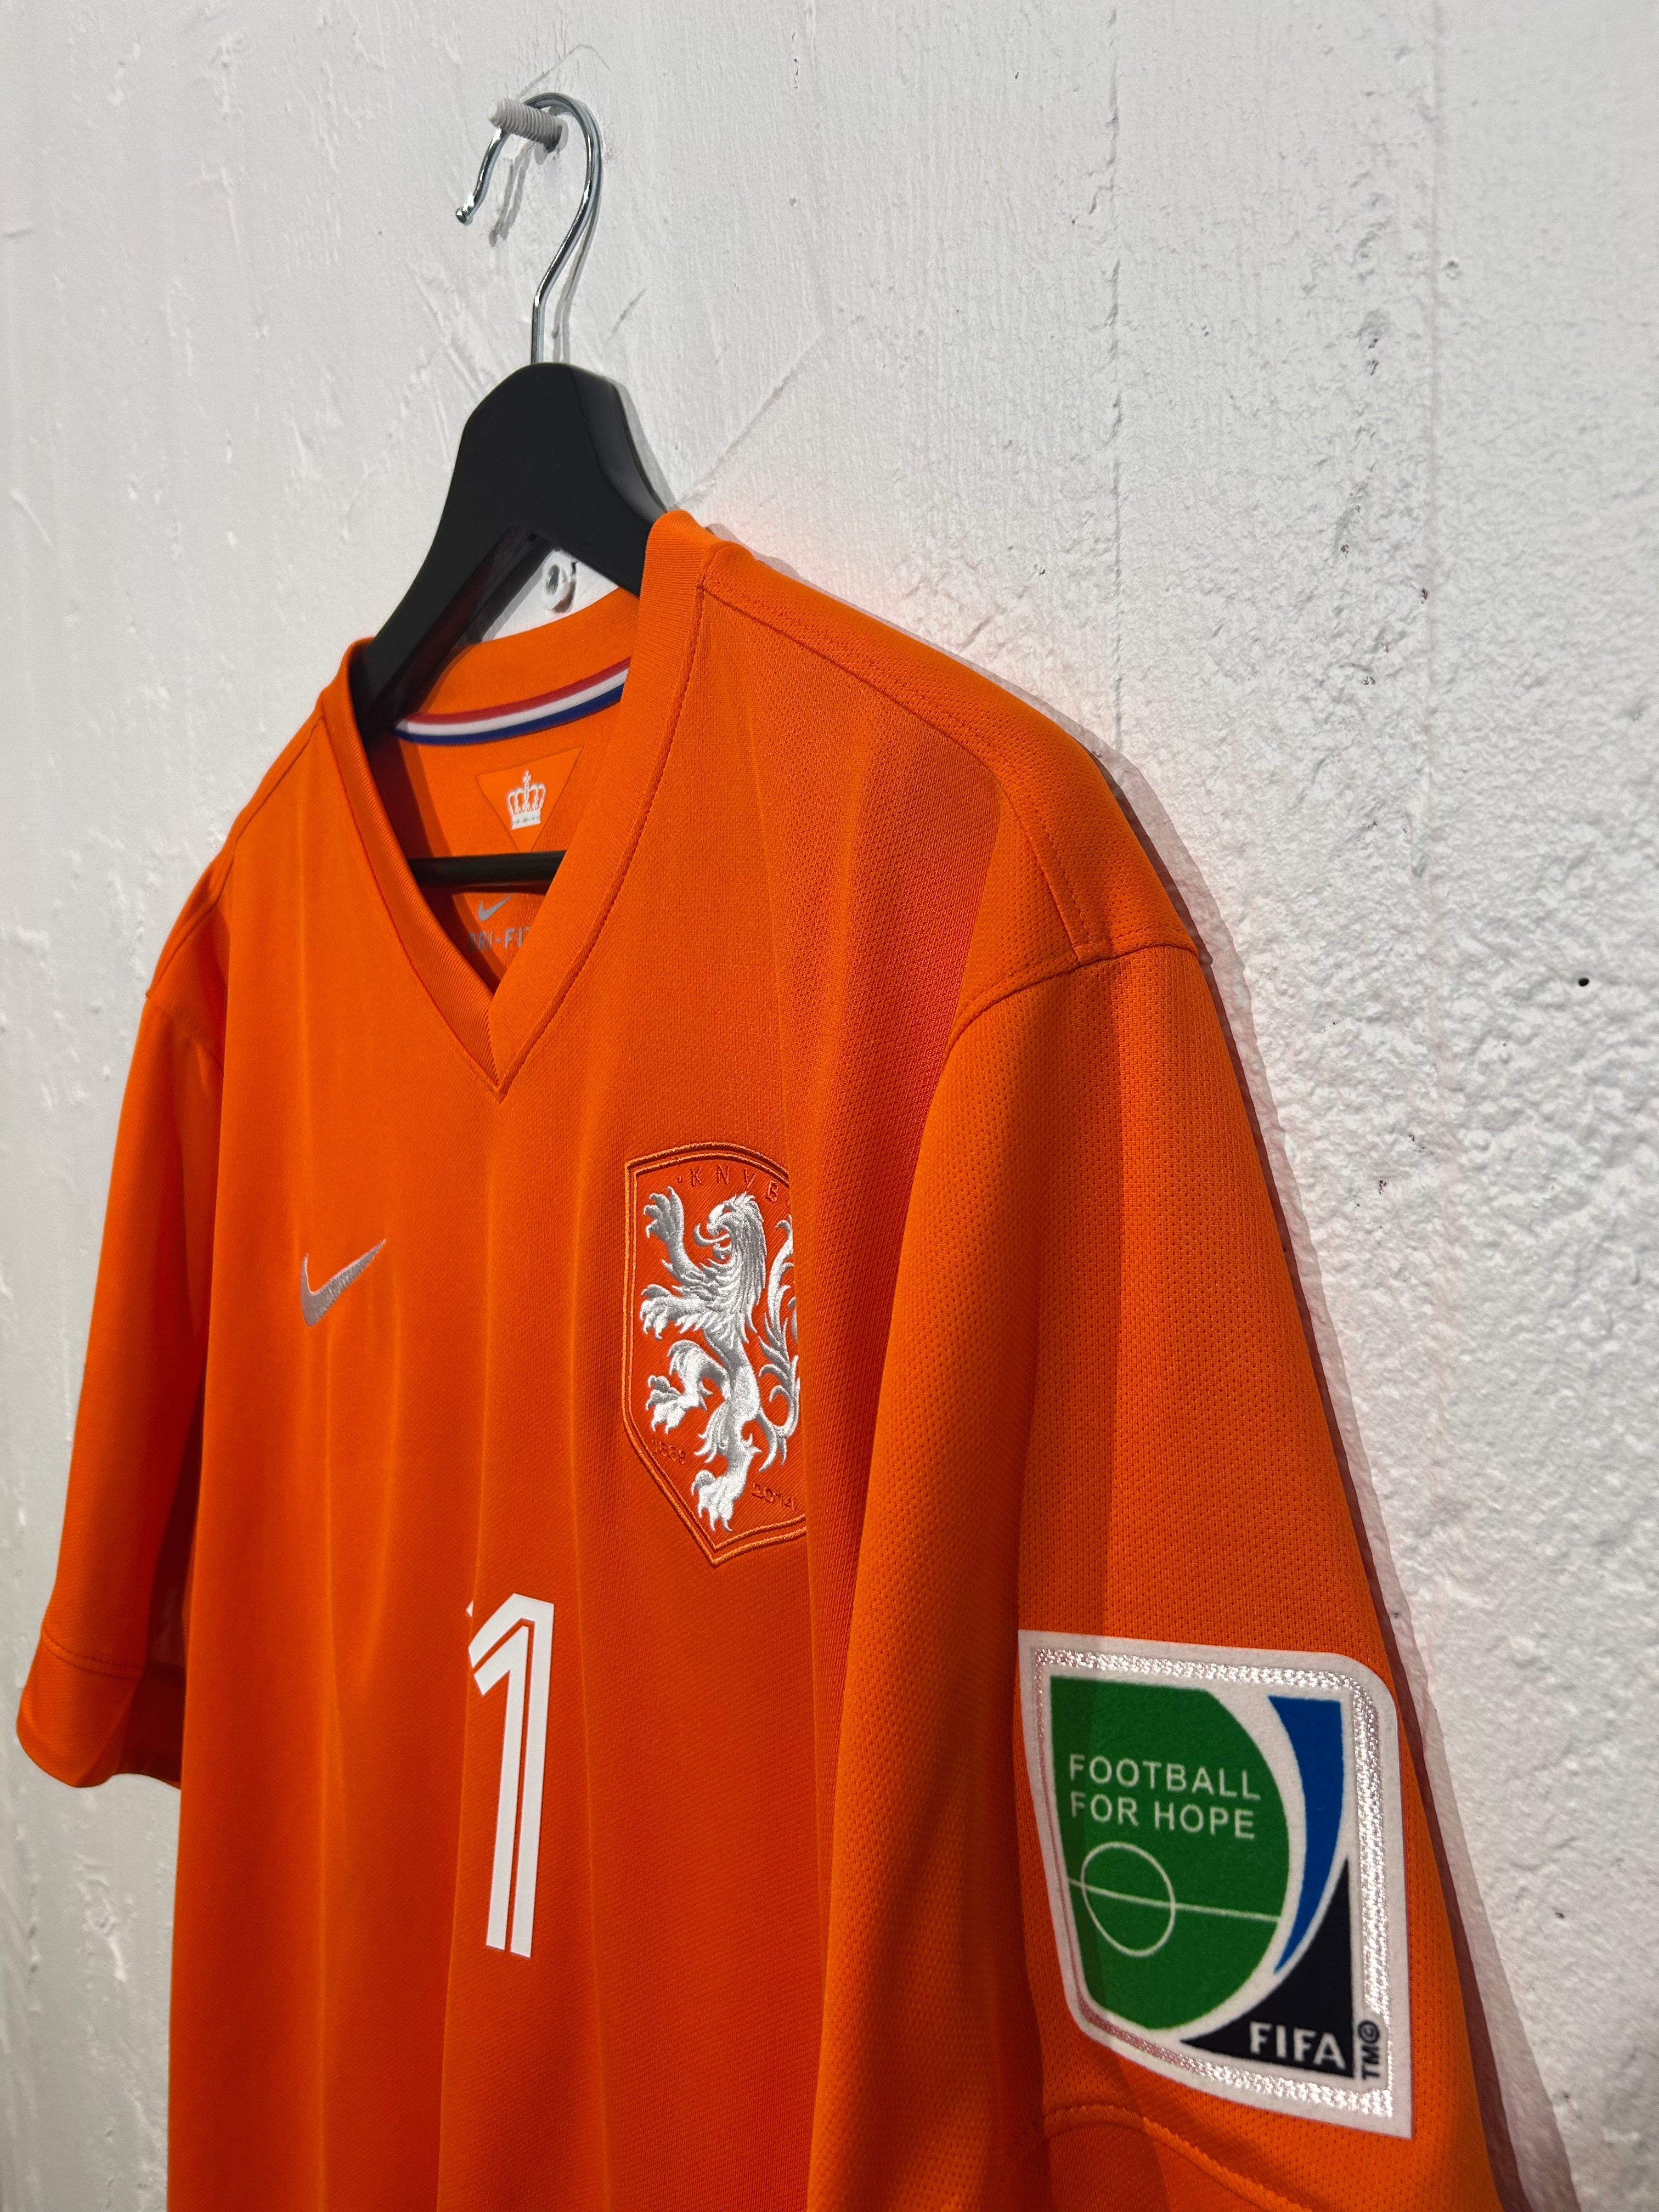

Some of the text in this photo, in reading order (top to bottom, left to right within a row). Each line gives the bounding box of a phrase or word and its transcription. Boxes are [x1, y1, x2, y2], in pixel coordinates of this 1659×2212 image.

[1069, 1753, 1261, 1800] FOOTBALL
[1070, 1791, 1255, 1840] FOR HOPE
[1249, 2021, 1345, 2070] FIFA
